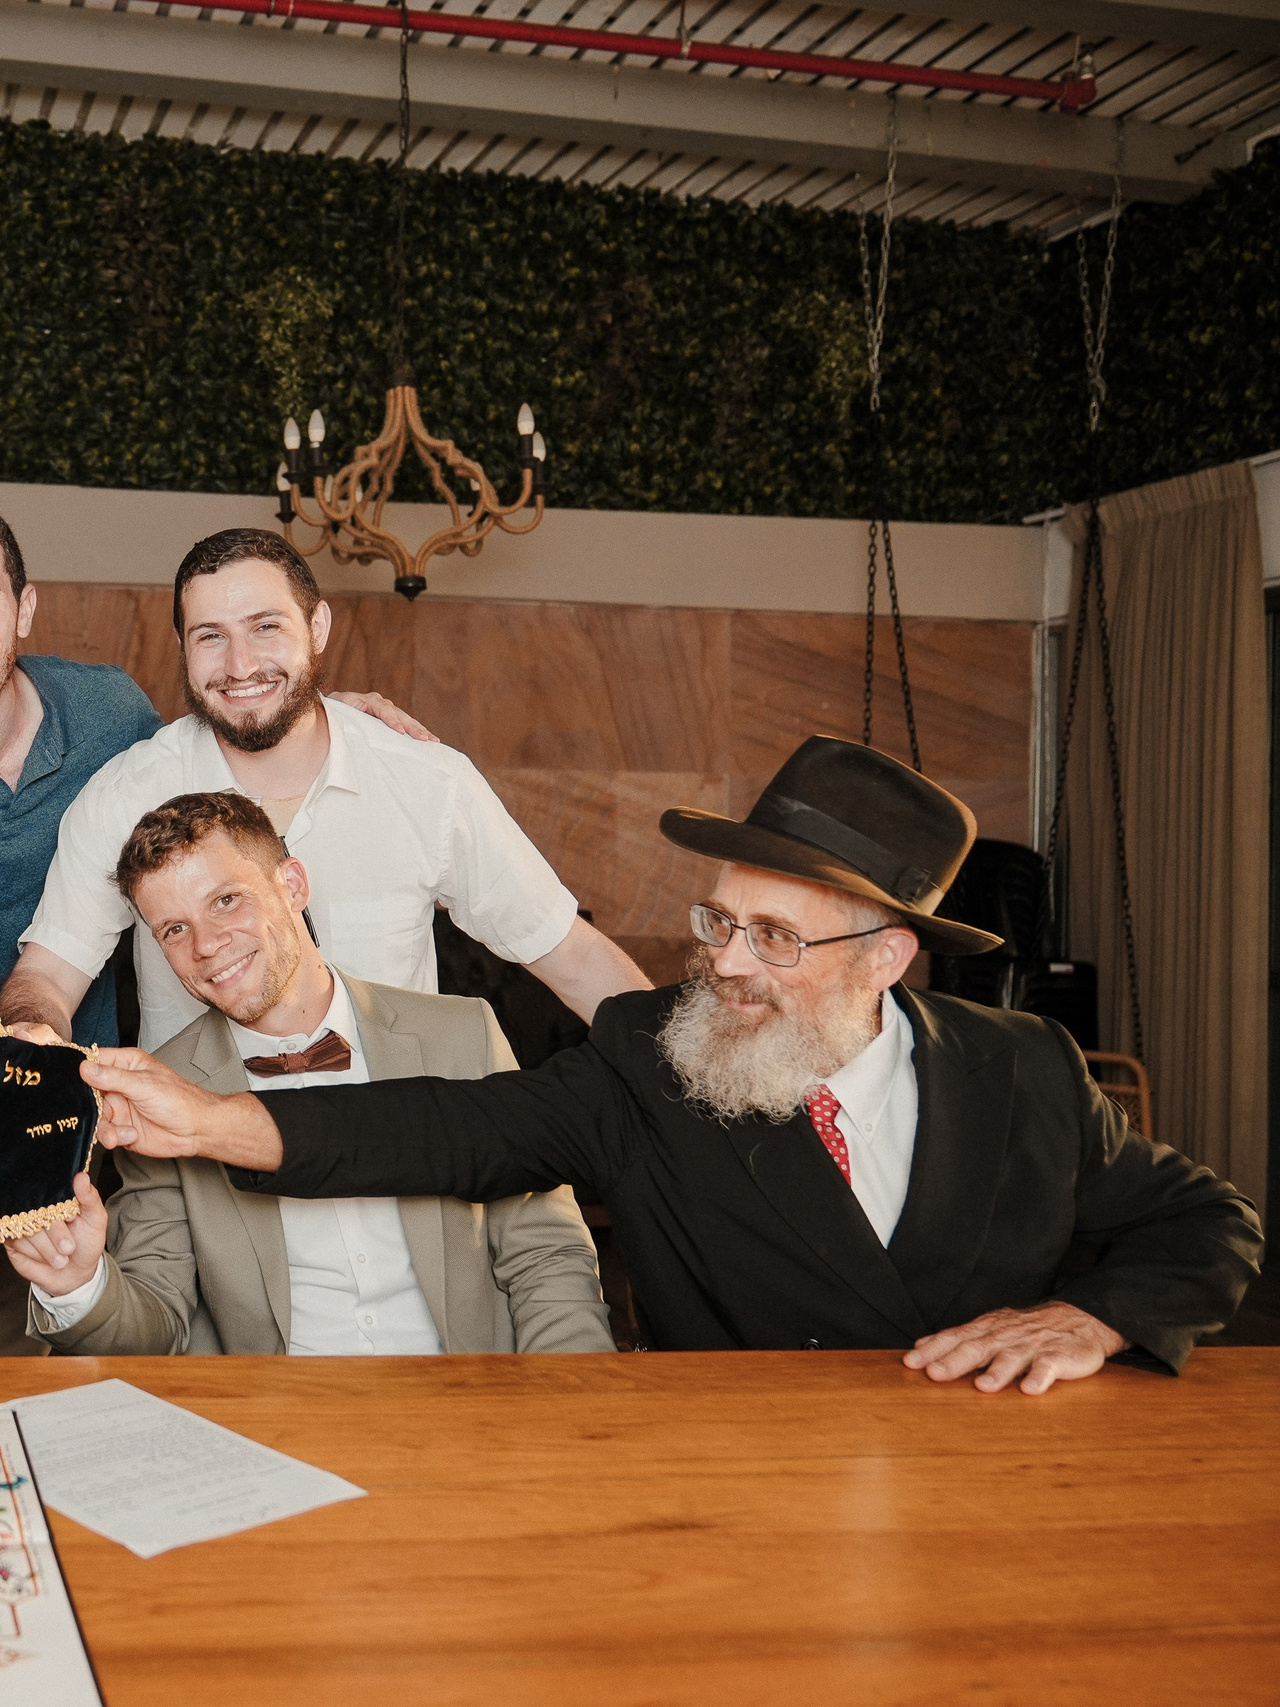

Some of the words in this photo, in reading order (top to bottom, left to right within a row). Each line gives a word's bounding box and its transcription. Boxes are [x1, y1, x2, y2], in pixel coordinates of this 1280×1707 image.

[3, 1060, 41, 1086] מזל
[26, 1123, 52, 1138] סודר
[57, 1116, 79, 1133] קנין
